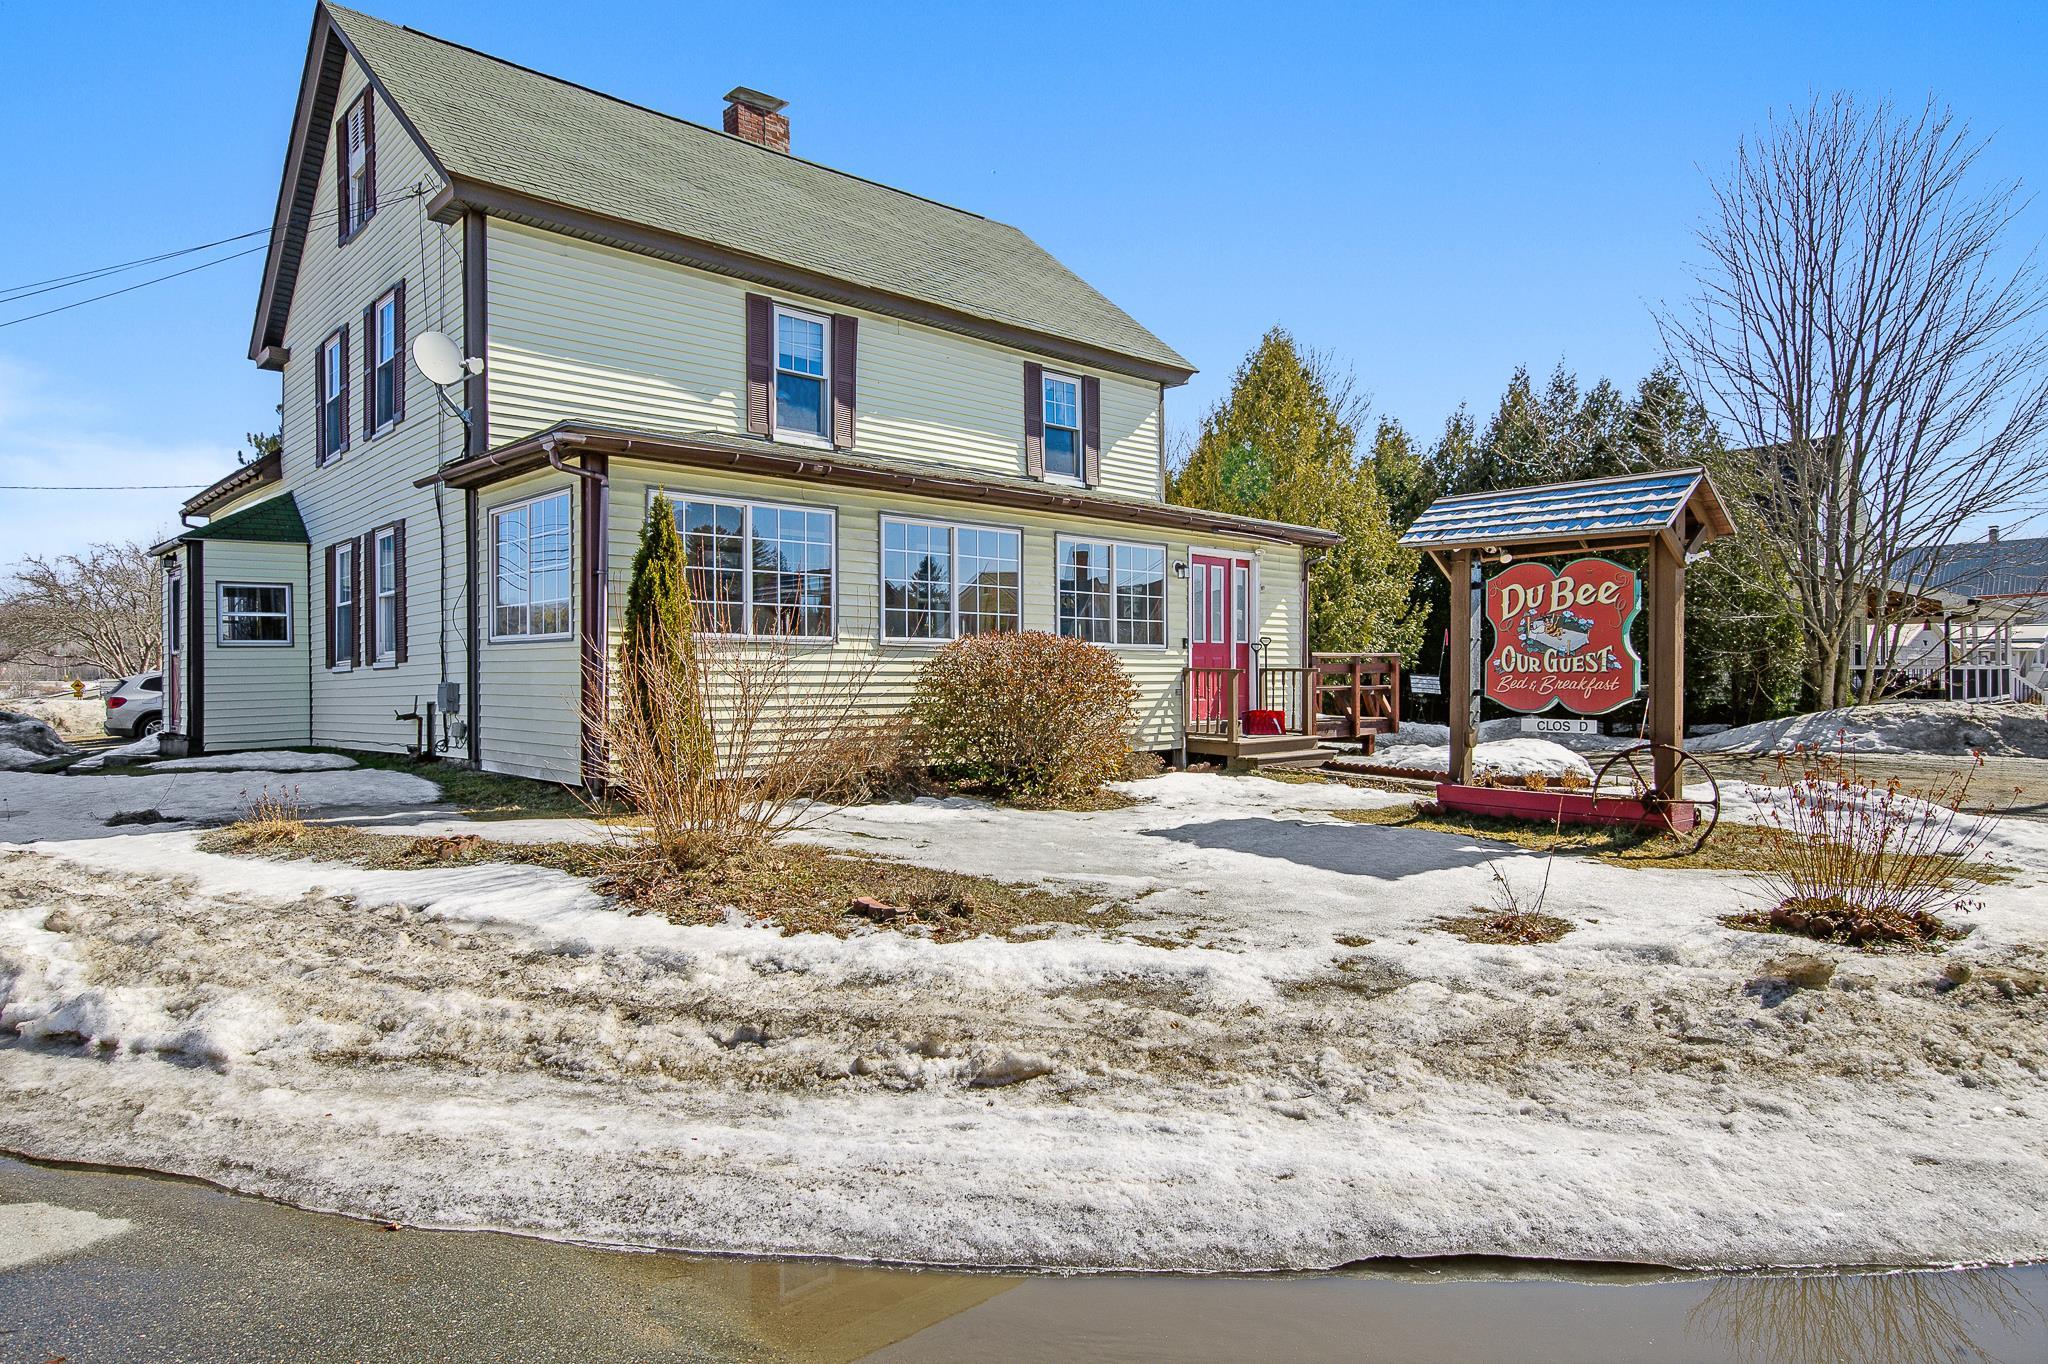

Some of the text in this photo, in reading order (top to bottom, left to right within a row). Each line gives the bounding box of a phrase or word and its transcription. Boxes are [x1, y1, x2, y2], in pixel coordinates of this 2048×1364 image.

[1548, 576, 1620, 614] Bee
[1495, 675, 1619, 699] Bed & Breakfast
